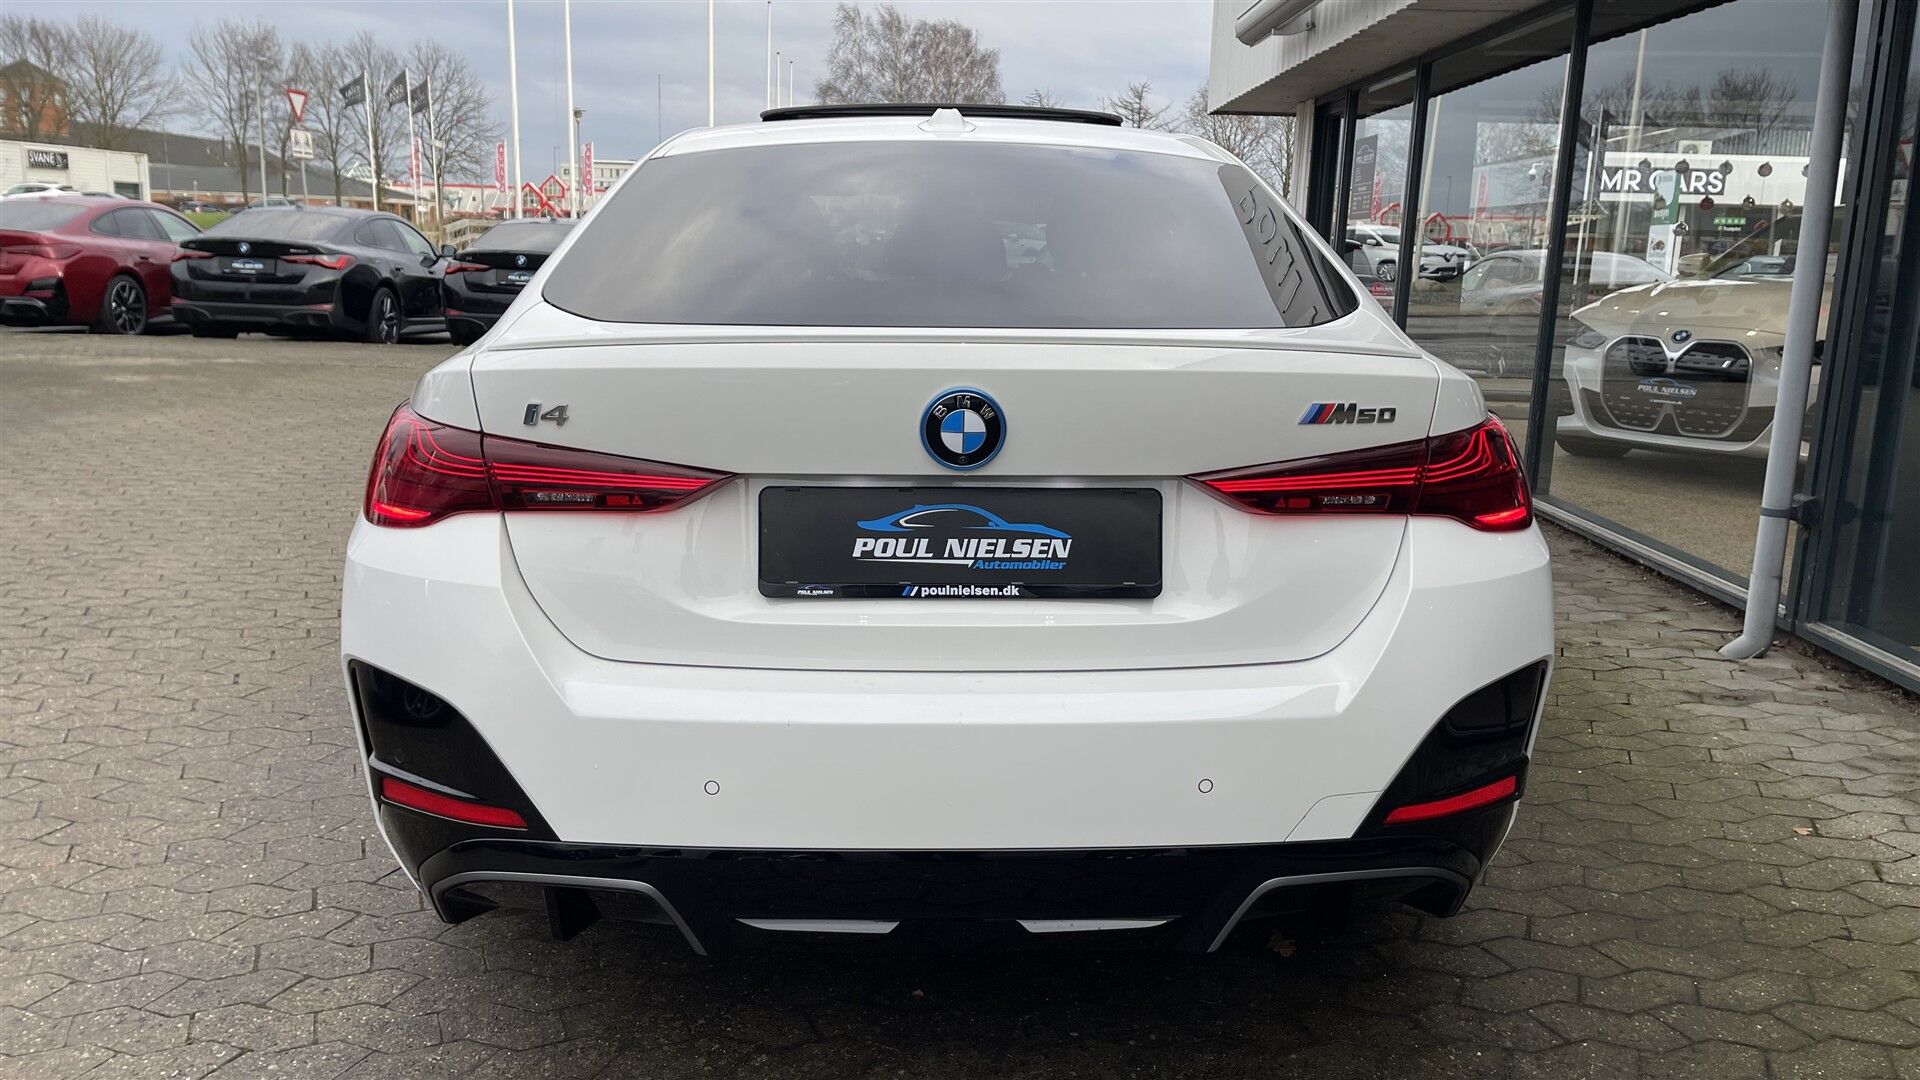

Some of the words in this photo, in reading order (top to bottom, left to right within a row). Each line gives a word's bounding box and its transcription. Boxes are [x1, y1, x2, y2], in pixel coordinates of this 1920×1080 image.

[29, 151, 55, 163] SVANE
[1600, 168, 1642, 191] MR
[1661, 387, 1697, 396] NIELSEN
[933, 395, 995, 420] BMW
[1325, 402, 1397, 424] M50
[852, 537, 933, 558] POUL
[943, 538, 1073, 558] NIELSEN
[972, 559, 1067, 570] Automobiler
[921, 584, 1020, 597] poulnielsen.dk
